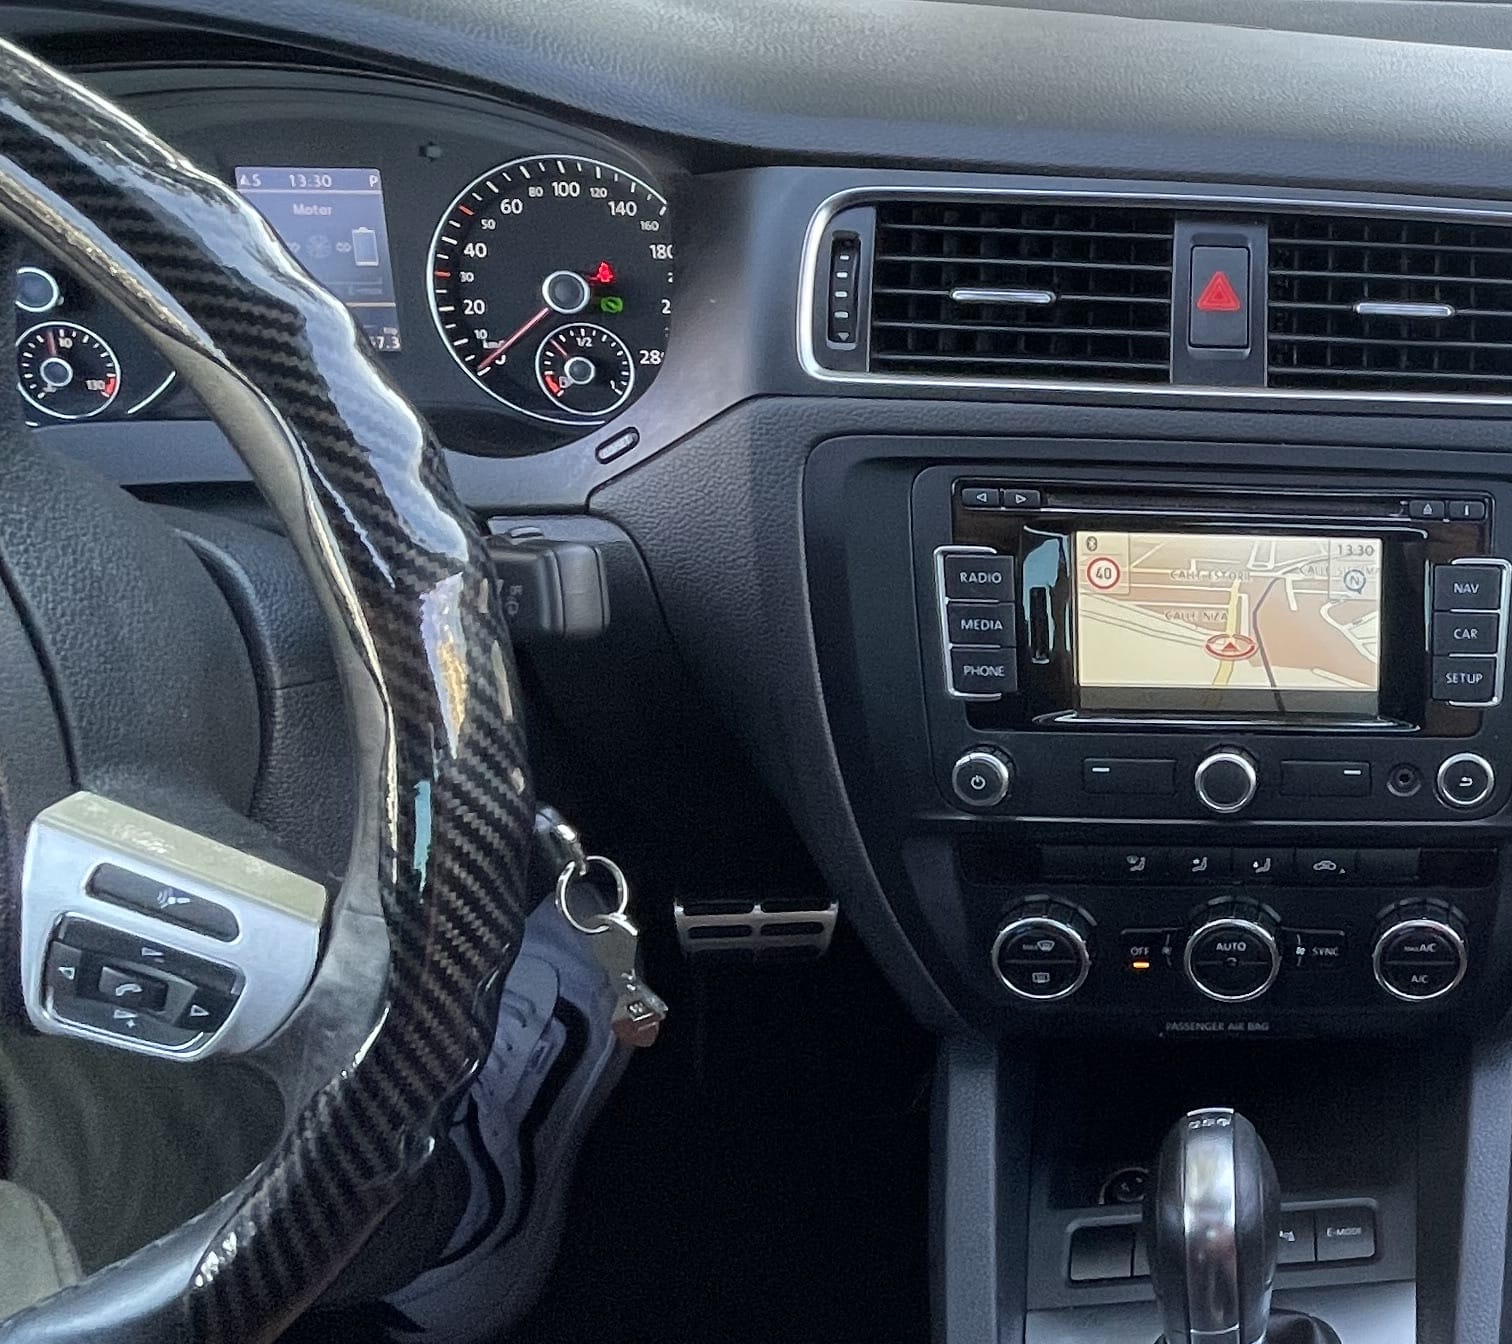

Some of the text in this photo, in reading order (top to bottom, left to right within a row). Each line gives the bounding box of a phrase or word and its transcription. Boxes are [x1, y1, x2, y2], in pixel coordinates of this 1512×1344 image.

[289, 174, 332, 188] 13:30
[369, 174, 379, 188] P
[528, 186, 543, 197] 80
[552, 181, 579, 197] 100
[590, 186, 607, 198] 120
[501, 199, 523, 215] 60
[608, 201, 637, 217] 140
[481, 219, 495, 230] 50
[640, 220, 659, 231] 160
[464, 242, 487, 258] 40
[464, 299, 485, 315] 20
[474, 329, 487, 340] 10
[639, 350, 665, 365] 28
[959, 572, 1002, 583] RADIO
[1095, 567, 1112, 580] 40
[1453, 583, 1479, 594] NAV
[960, 618, 1003, 630] MEDIA
[1453, 628, 1478, 640] CAR
[963, 665, 1005, 677] PHONE
[1445, 672, 1483, 684] SETUP
[1130, 947, 1150, 956] OFF
[1216, 941, 1247, 952] AUTO
[1312, 946, 1339, 957] SYNC
[1411, 974, 1428, 984] A/C
